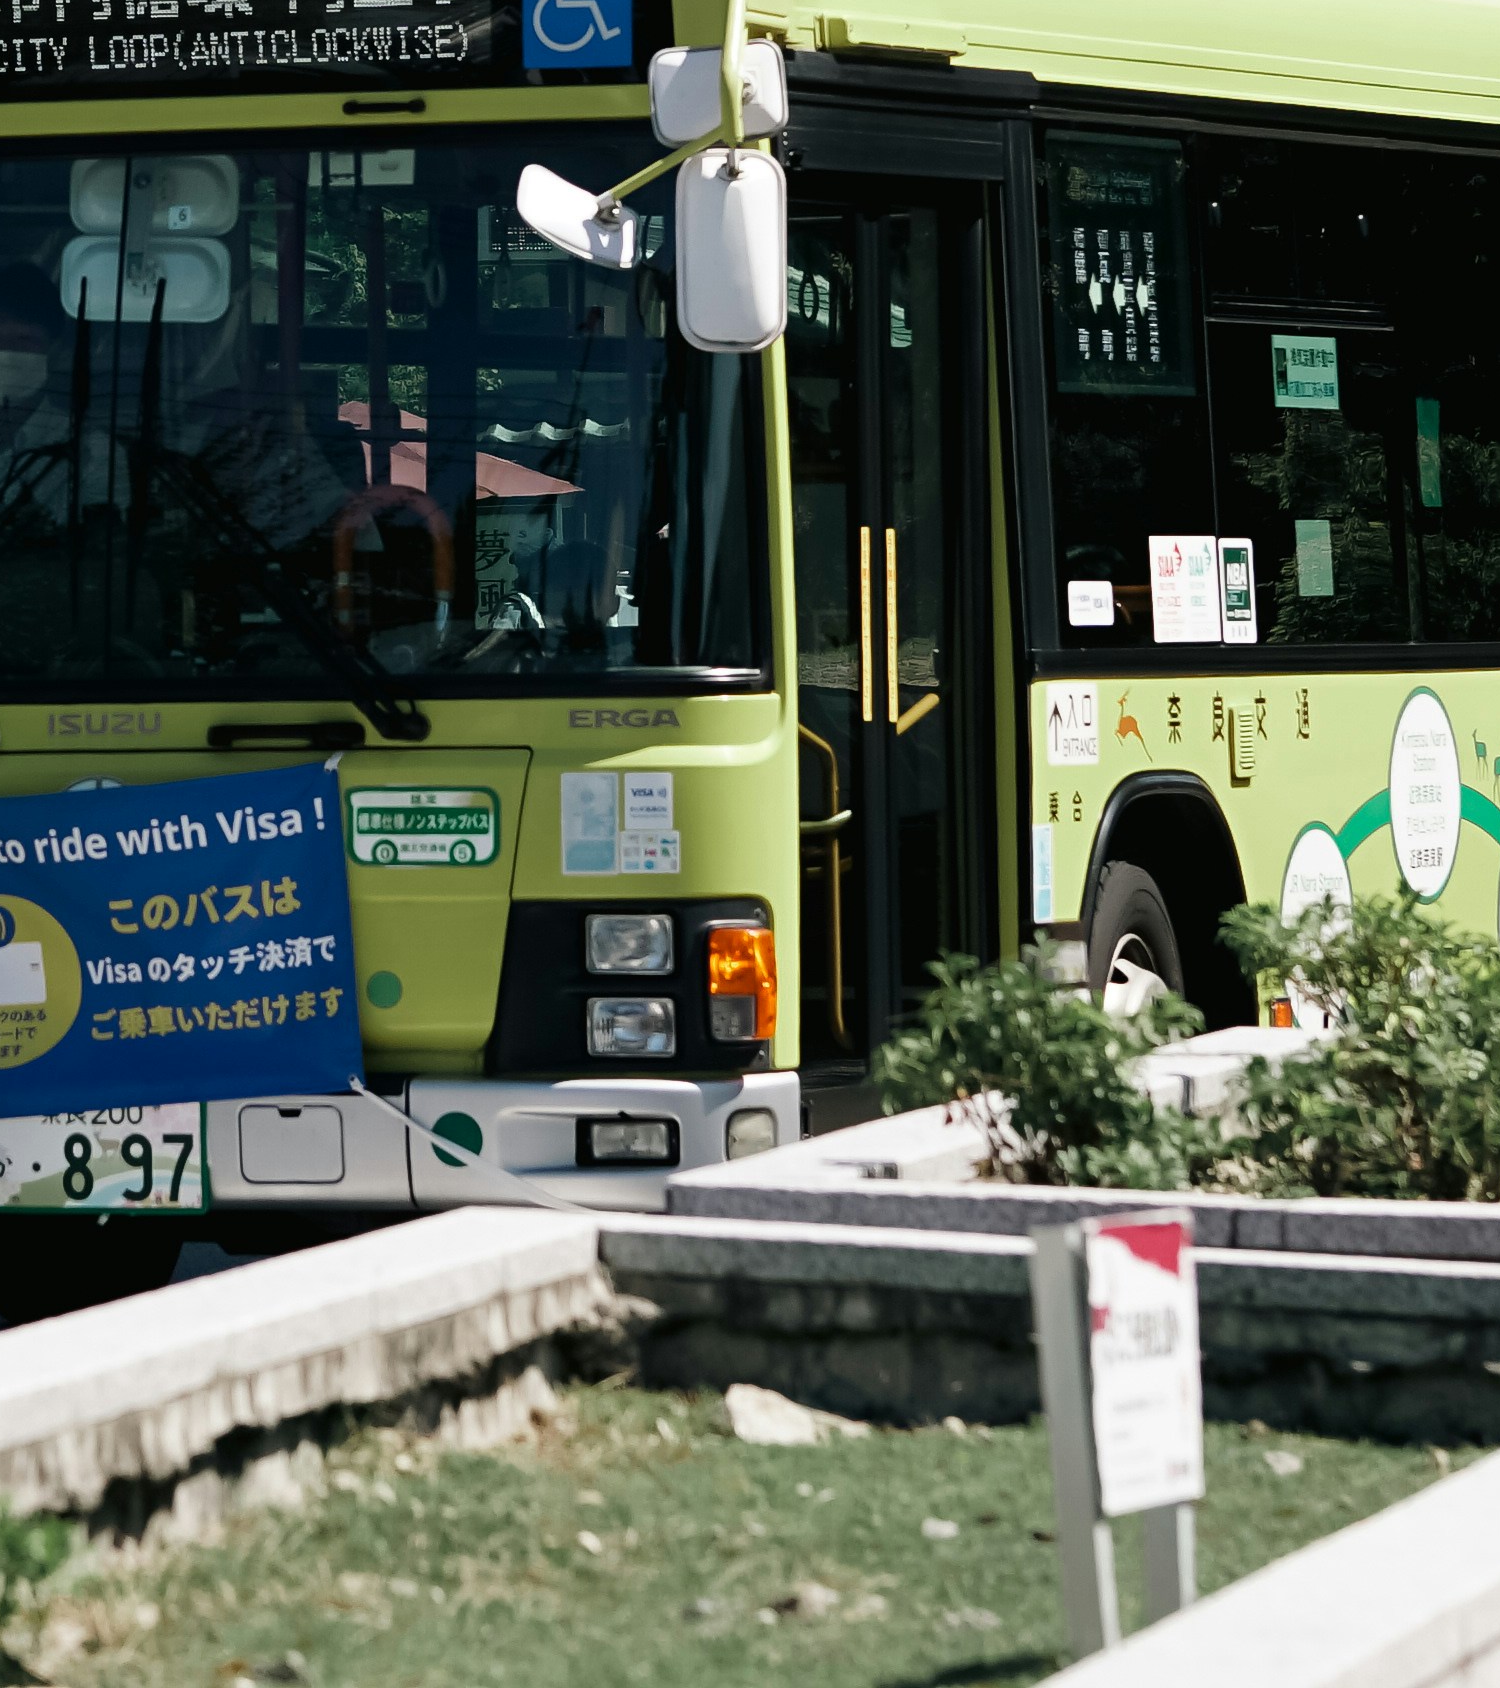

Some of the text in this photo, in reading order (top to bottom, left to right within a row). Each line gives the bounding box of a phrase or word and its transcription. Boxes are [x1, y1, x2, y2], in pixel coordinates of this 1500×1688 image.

[48, 713, 161, 736] ISUZU
[568, 709, 681, 729] ERGA
[1066, 694, 1093, 729] 入口
[1062, 737, 1098, 758] ENTRANCE
[33, 827, 108, 865] ride
[116, 814, 208, 857] with
[215, 806, 304, 845] Visa
[107, 876, 302, 935] このバスは
[86, 935, 338, 987] Visa のタッチ決済で
[90, 986, 345, 1042] ご乗車いただけます
